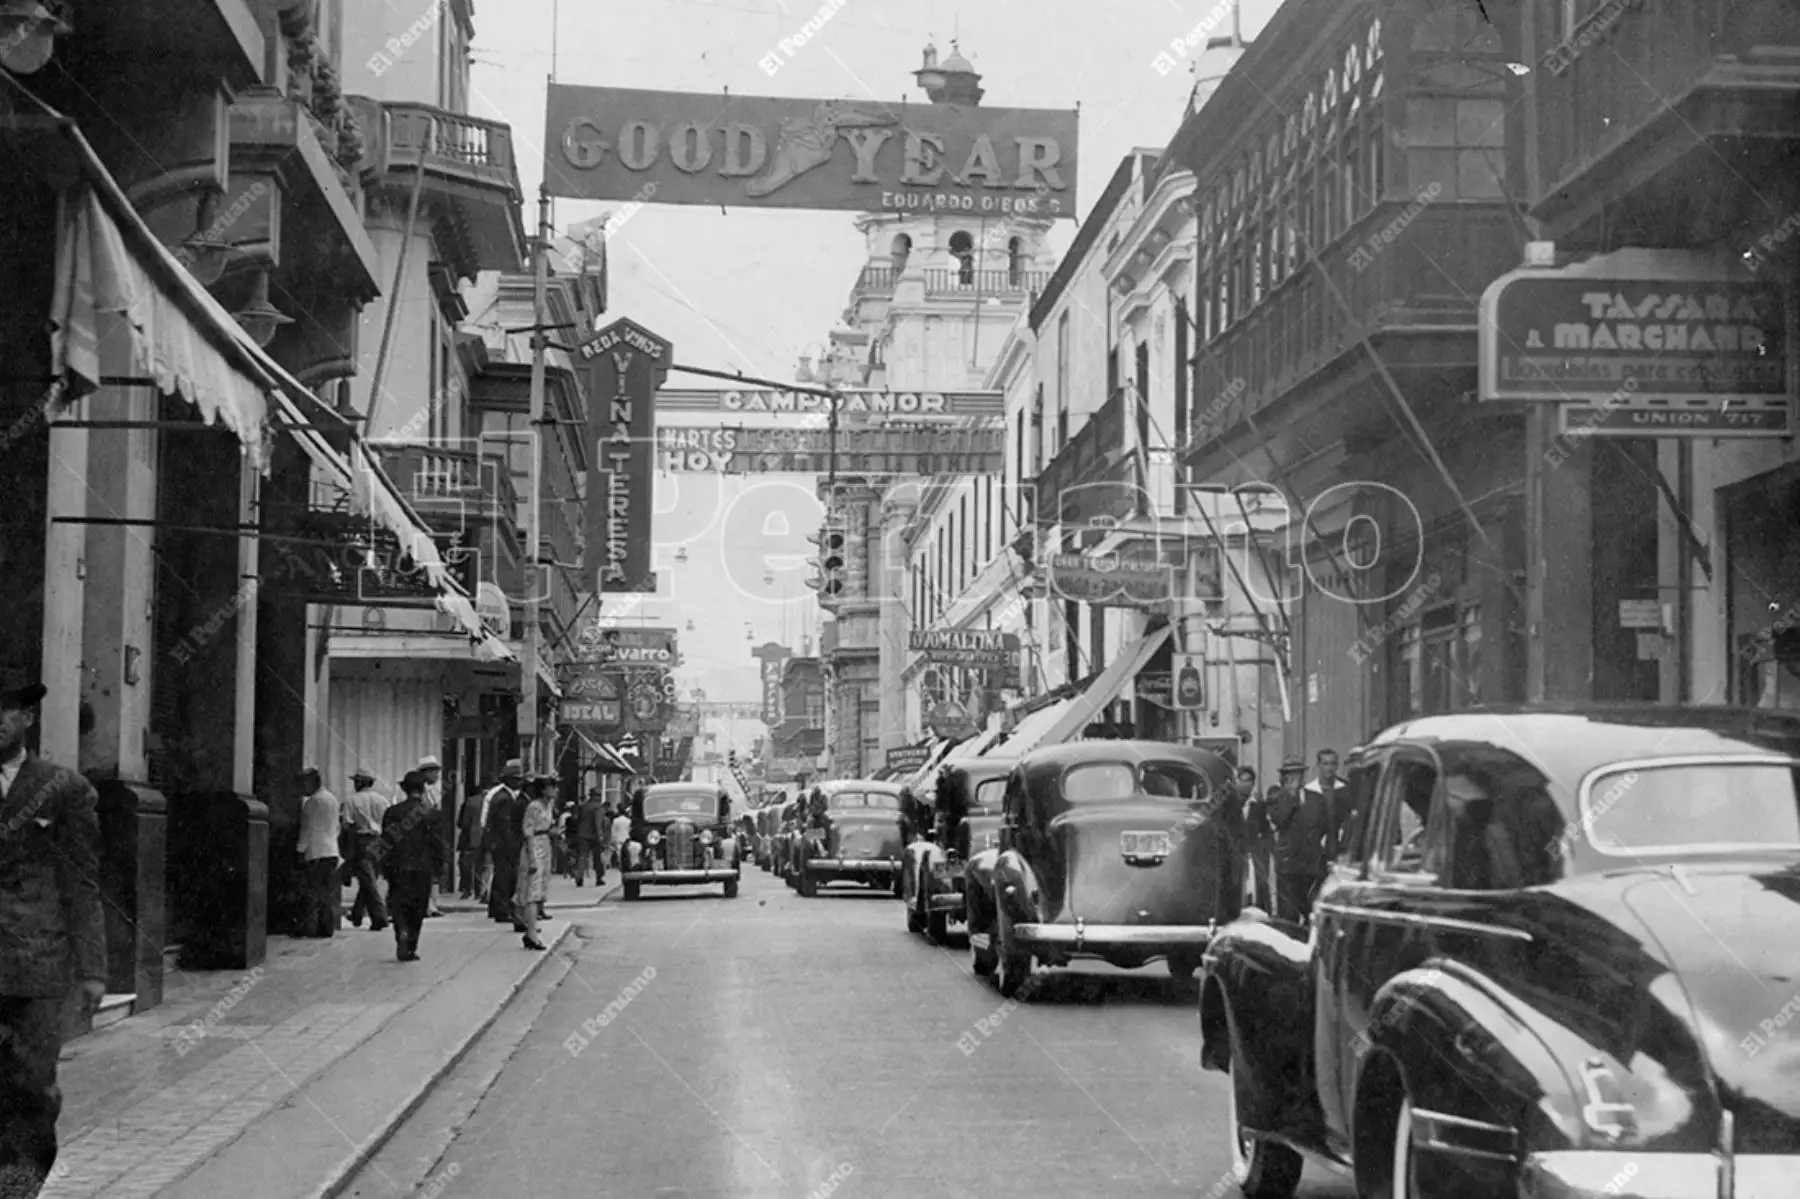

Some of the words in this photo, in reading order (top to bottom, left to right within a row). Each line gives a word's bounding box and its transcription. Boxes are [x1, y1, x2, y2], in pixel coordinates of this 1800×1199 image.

[561, 117, 769, 177] GOOD
[837, 126, 1067, 191] YEAR
[882, 191, 974, 211] EDUARDO
[1582, 292, 1760, 319] TASSARA
[624, 326, 665, 358] VINOS
[1554, 323, 1765, 349] MARCHAND
[724, 391, 946, 413] CAMPOAMOR
[1632, 412, 1710, 424] UNION
[663, 430, 735, 449] MARTES
[664, 451, 733, 471] HOY
[605, 452, 632, 584] TERESA
